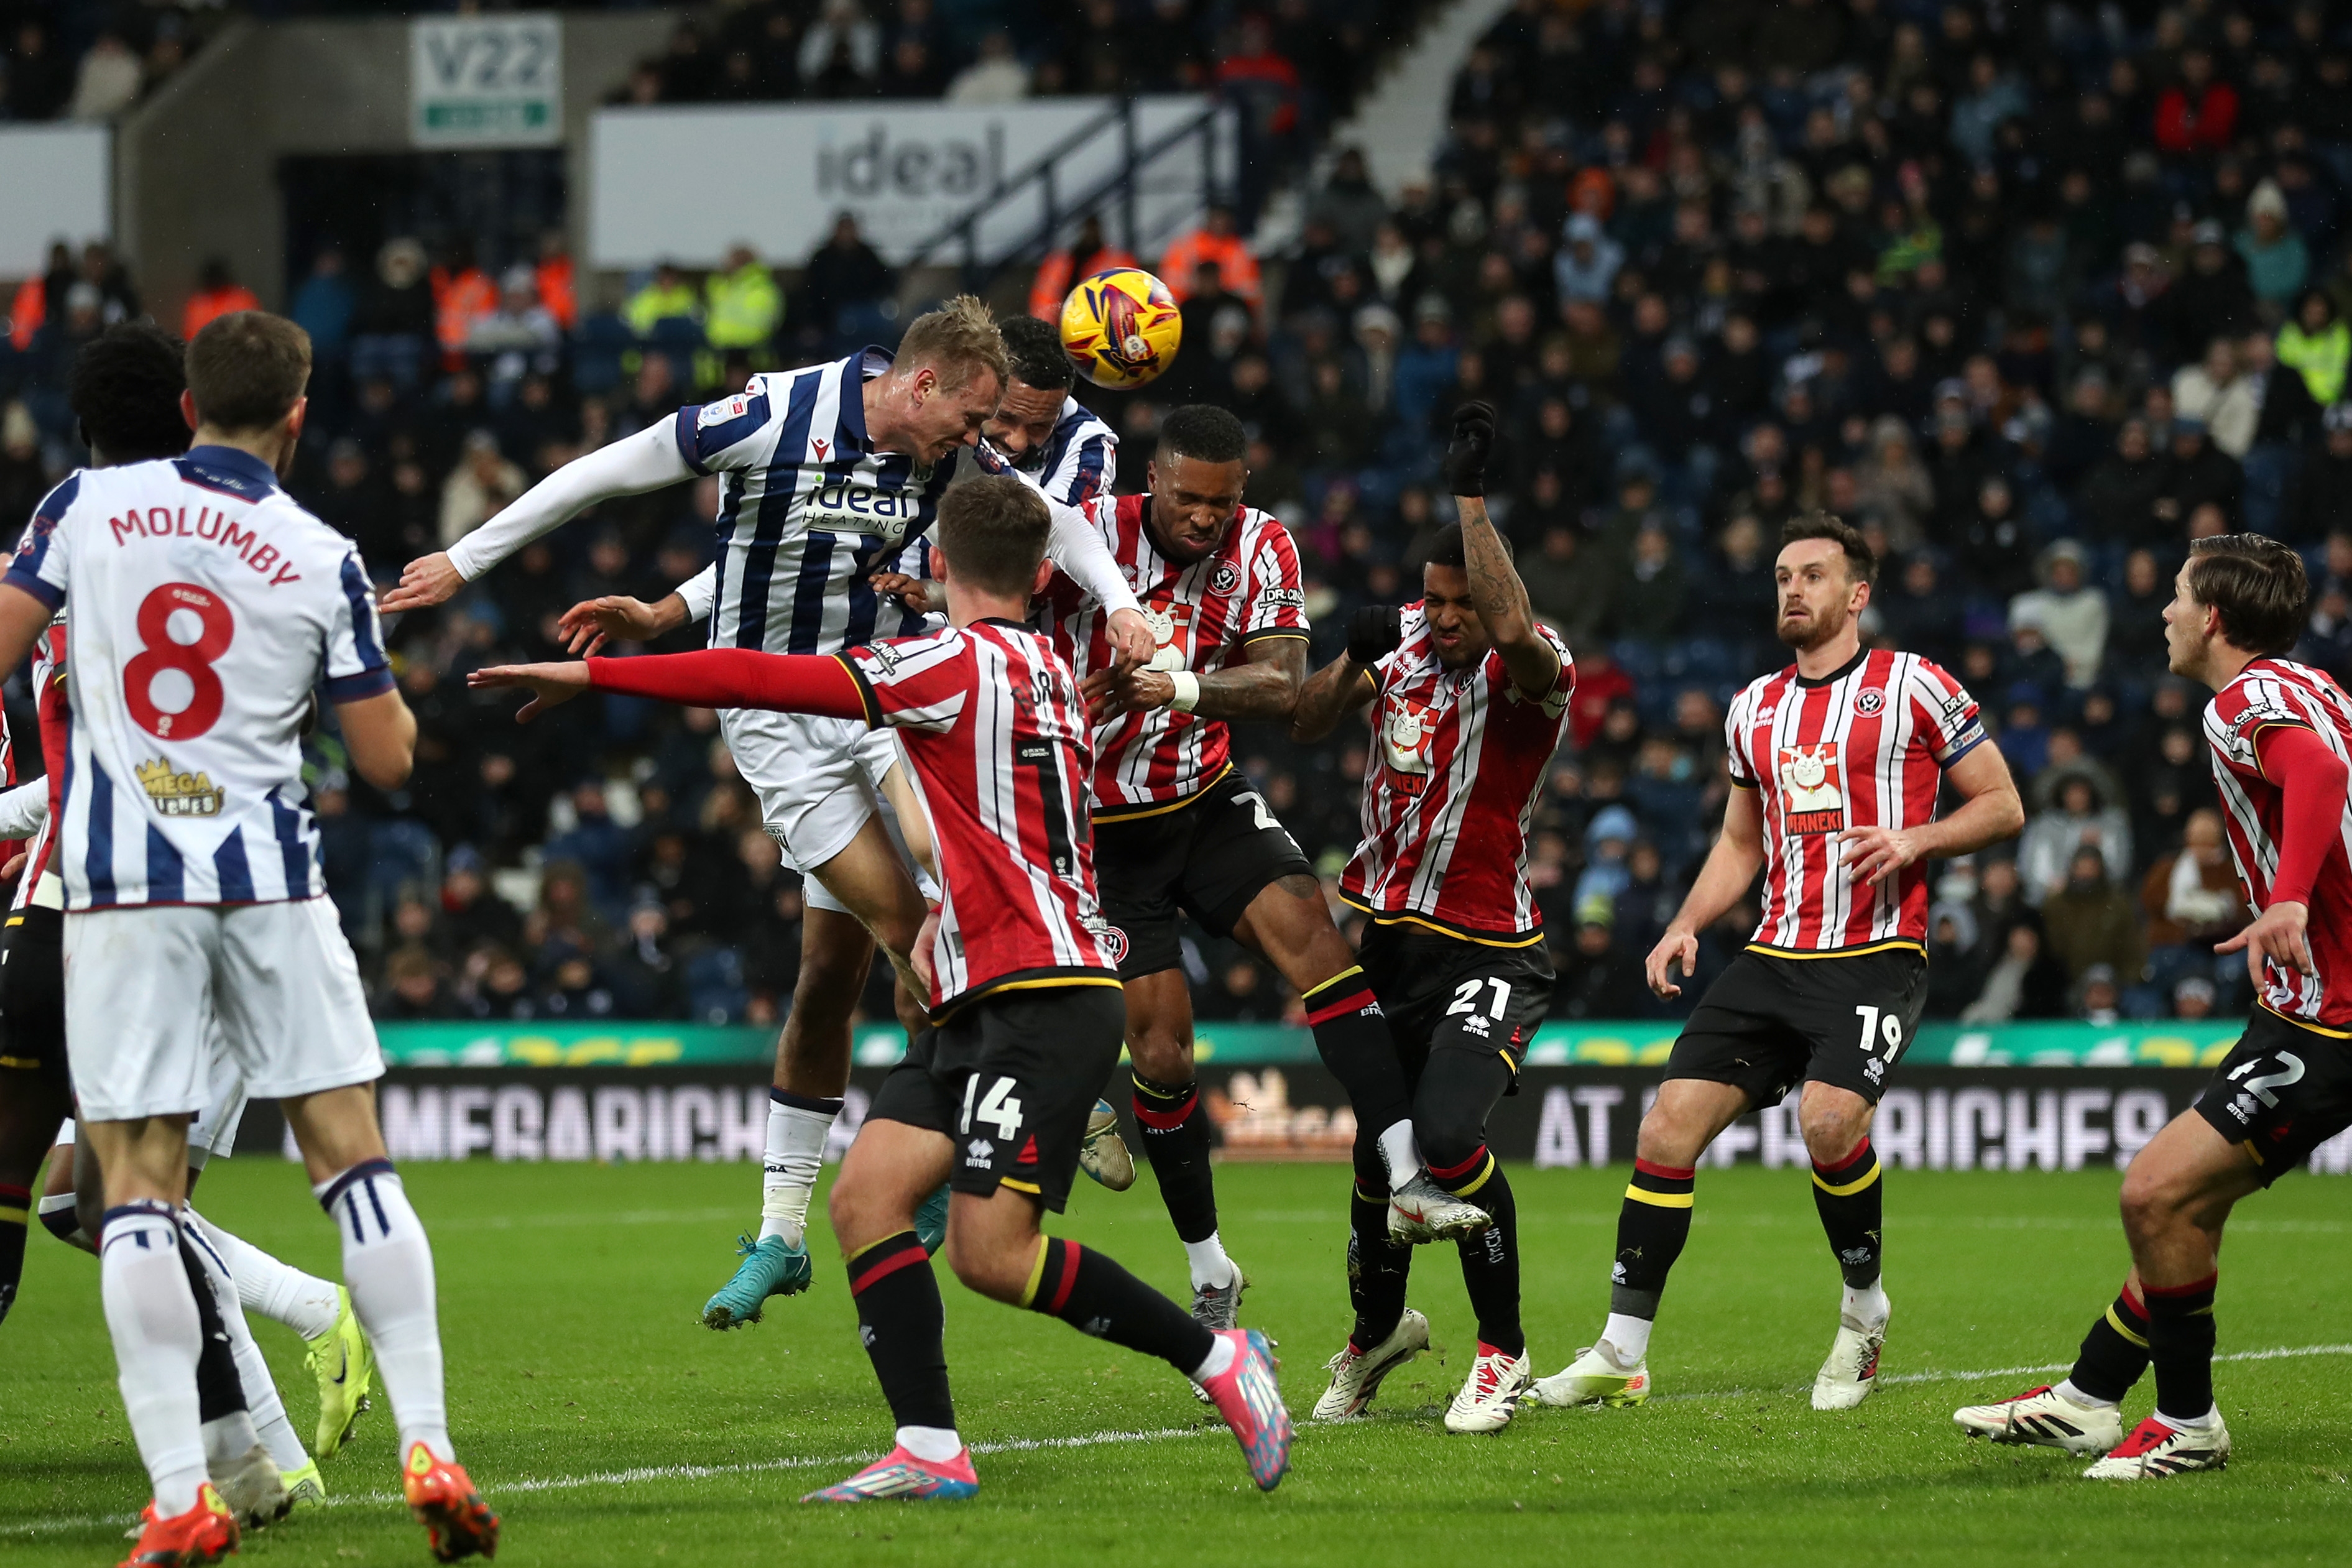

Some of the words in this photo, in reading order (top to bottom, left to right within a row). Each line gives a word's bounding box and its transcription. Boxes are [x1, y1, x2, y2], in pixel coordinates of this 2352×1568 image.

[425, 30, 546, 88] V22
[814, 119, 1007, 198] ideal
[806, 474, 913, 519] ideal
[802, 510, 905, 535] HEATING
[108, 505, 303, 587] MOLUMBY
[124, 582, 235, 741] 8
[1754, 719, 1773, 729] errea
[2234, 702, 2270, 724] CINIK
[144, 772, 213, 796] MEGA
[157, 795, 215, 816] ICHES
[1786, 811, 1843, 834] MANEKI
[1446, 976, 1511, 1022] 21
[1462, 1024, 1490, 1039] errea
[1855, 1005, 1902, 1064] 19
[1863, 1068, 1881, 1086] errea
[382, 1082, 872, 1164] MEGARICHS
[961, 1071, 1024, 1141] 14
[2225, 1102, 2250, 1125] errea
[1533, 1084, 1625, 1170] AT
[966, 1156, 992, 1170] errea
